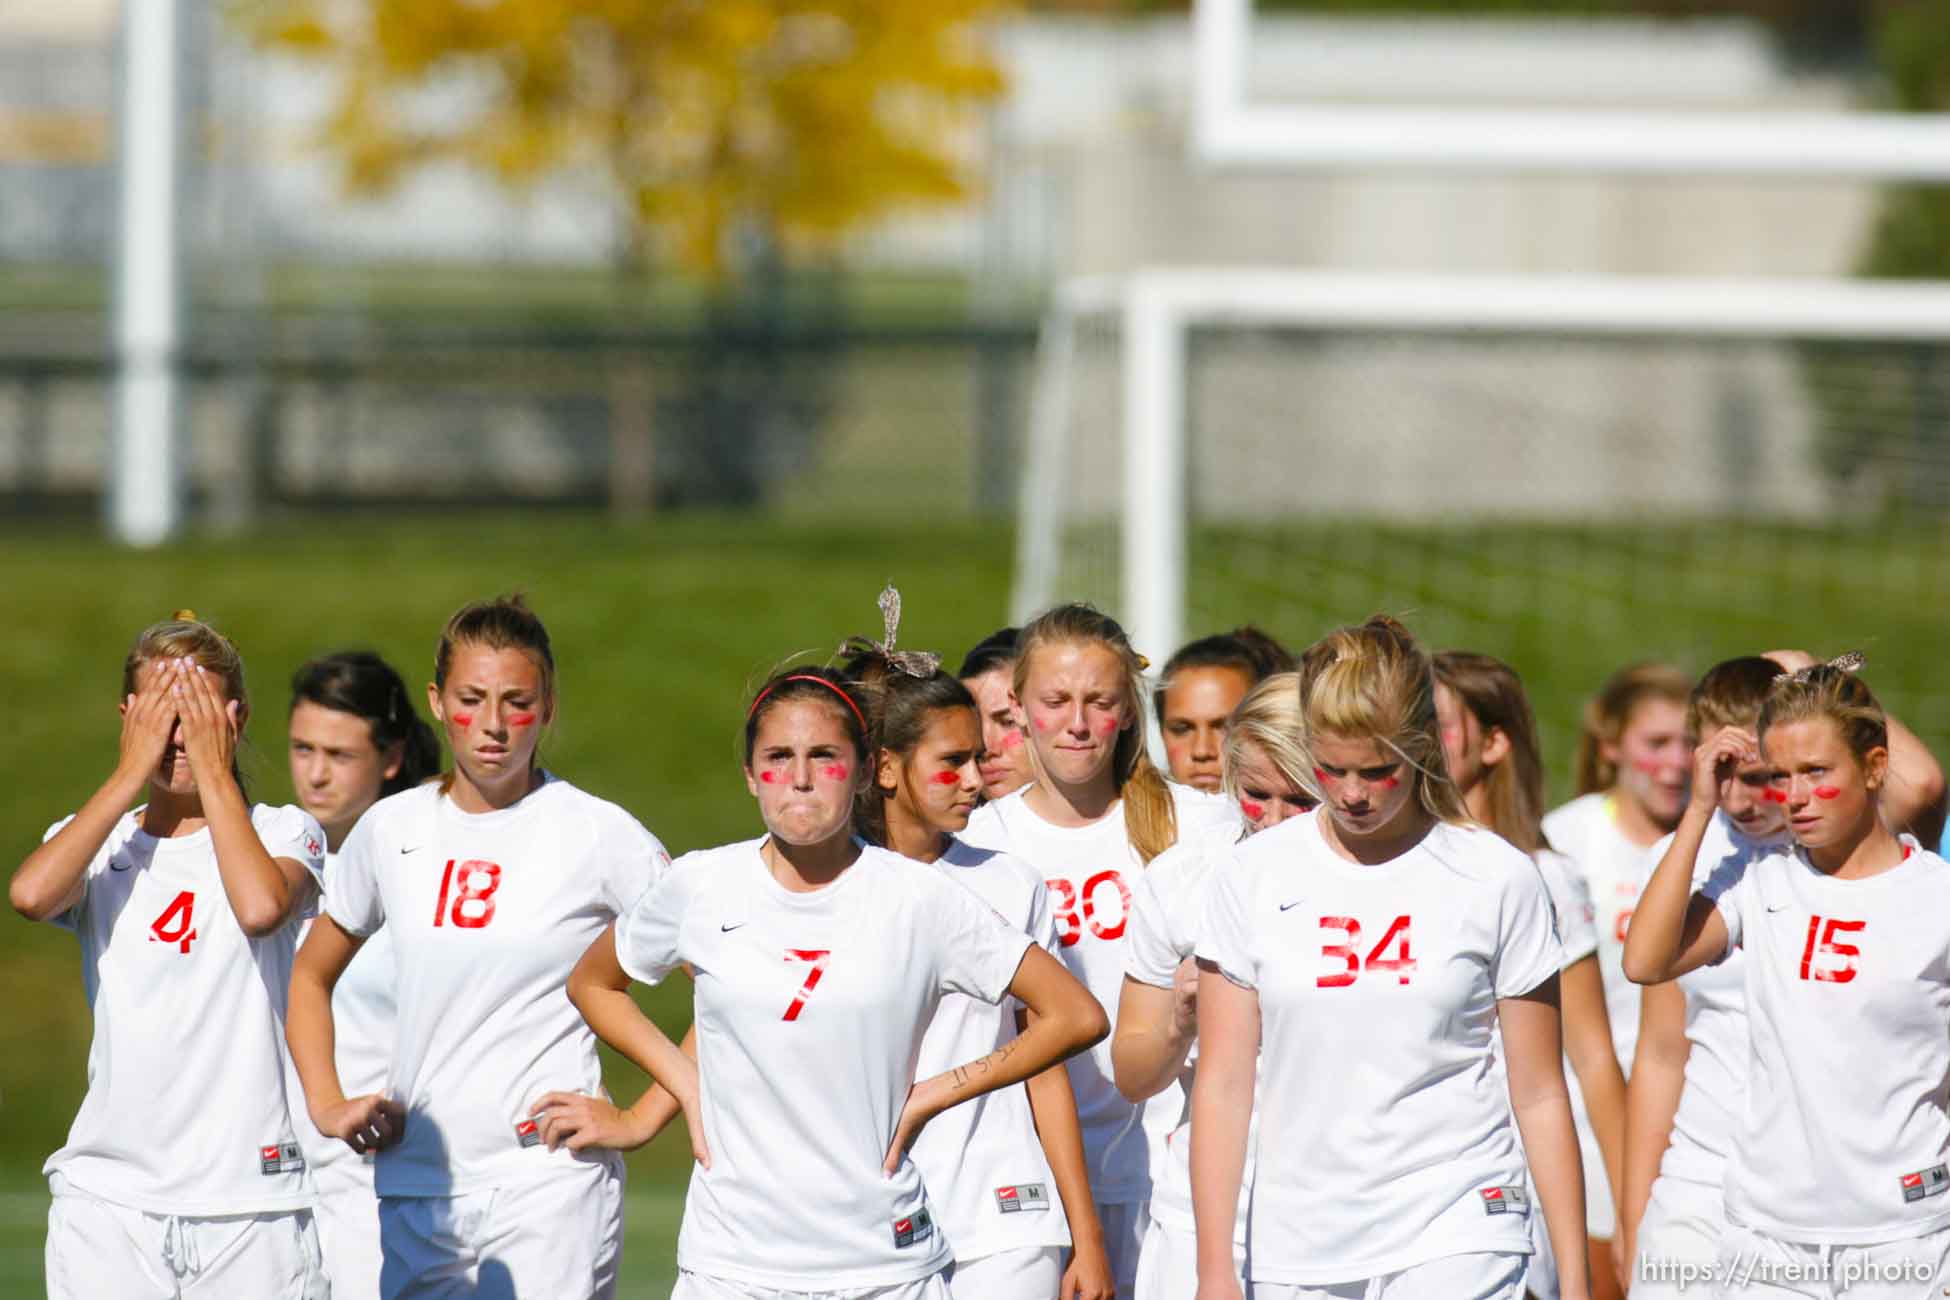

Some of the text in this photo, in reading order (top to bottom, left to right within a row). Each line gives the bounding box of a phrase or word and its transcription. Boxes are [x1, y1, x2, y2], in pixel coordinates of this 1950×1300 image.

[148, 891, 198, 954] 4
[433, 860, 503, 929] 18
[1045, 870, 1132, 949] 30
[1316, 915, 1417, 990] 34
[1800, 915, 1868, 985] 15
[782, 949, 831, 1023] 7
[1028, 1187, 1040, 1199] M
[1511, 1189, 1521, 1201] L
